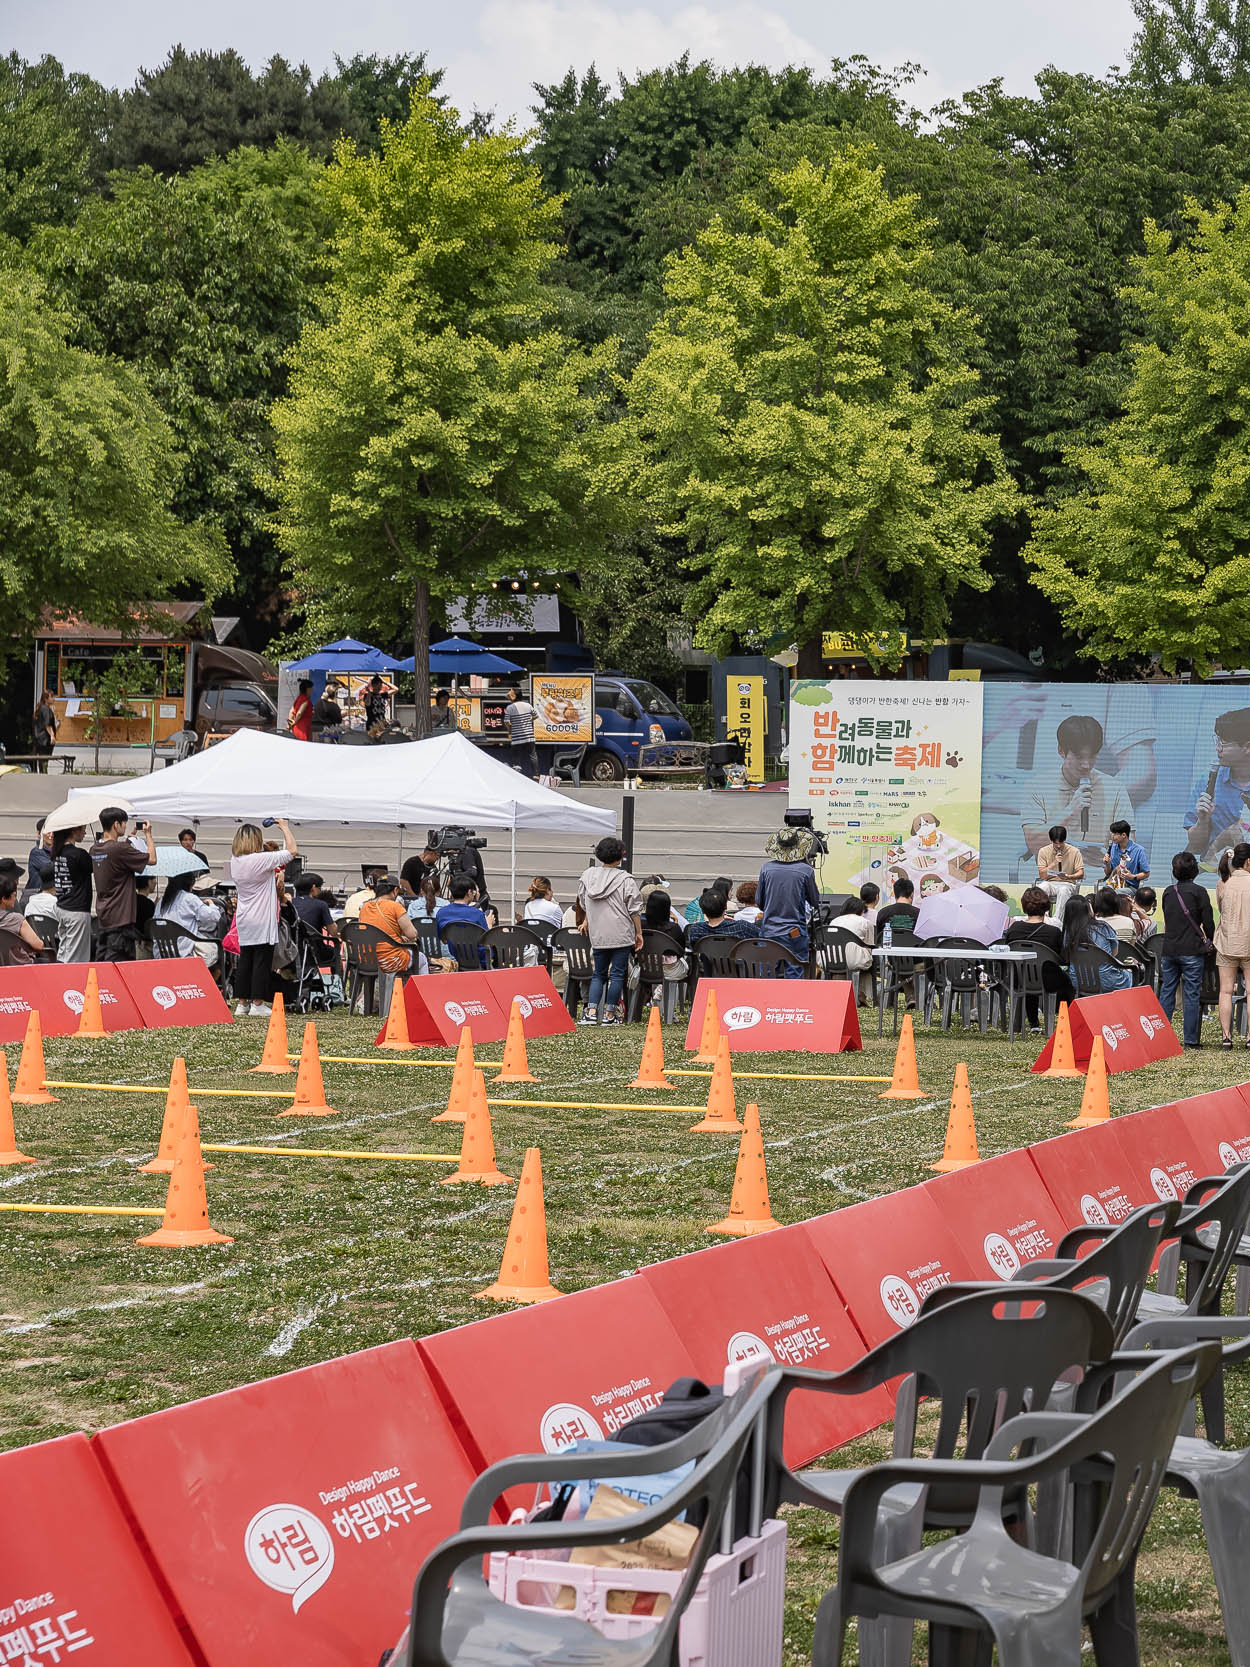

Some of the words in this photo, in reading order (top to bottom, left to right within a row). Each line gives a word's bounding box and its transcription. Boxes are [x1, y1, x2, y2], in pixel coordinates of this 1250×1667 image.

[878, 697, 909, 706] 반한축제!
[912, 697, 932, 706] 신나는
[814, 711, 912, 742] 반려동물과
[731, 1011, 753, 1023] 하림
[765, 1013, 814, 1024] 하림펫푸드
[1015, 1229, 1053, 1259] 하림펫푸드
[887, 1286, 914, 1316] 하림
[764, 1323, 781, 1336] Design
[780, 1318, 796, 1332] Happy
[794, 1313, 810, 1324] Dance
[774, 1326, 830, 1365] 하림펫푸드
[591, 1390, 614, 1407] Design
[612, 1384, 633, 1401] Happy
[630, 1377, 651, 1390] Dance
[318, 1484, 350, 1505] Design
[349, 1475, 376, 1495] Happy
[373, 1466, 400, 1484] Dance
[332, 1482, 432, 1544] 하림펫푸드
[259, 1520, 319, 1571] 하림
[14, 1592, 56, 1616] Dance
[0, 1610, 95, 1667] 펫푸드
